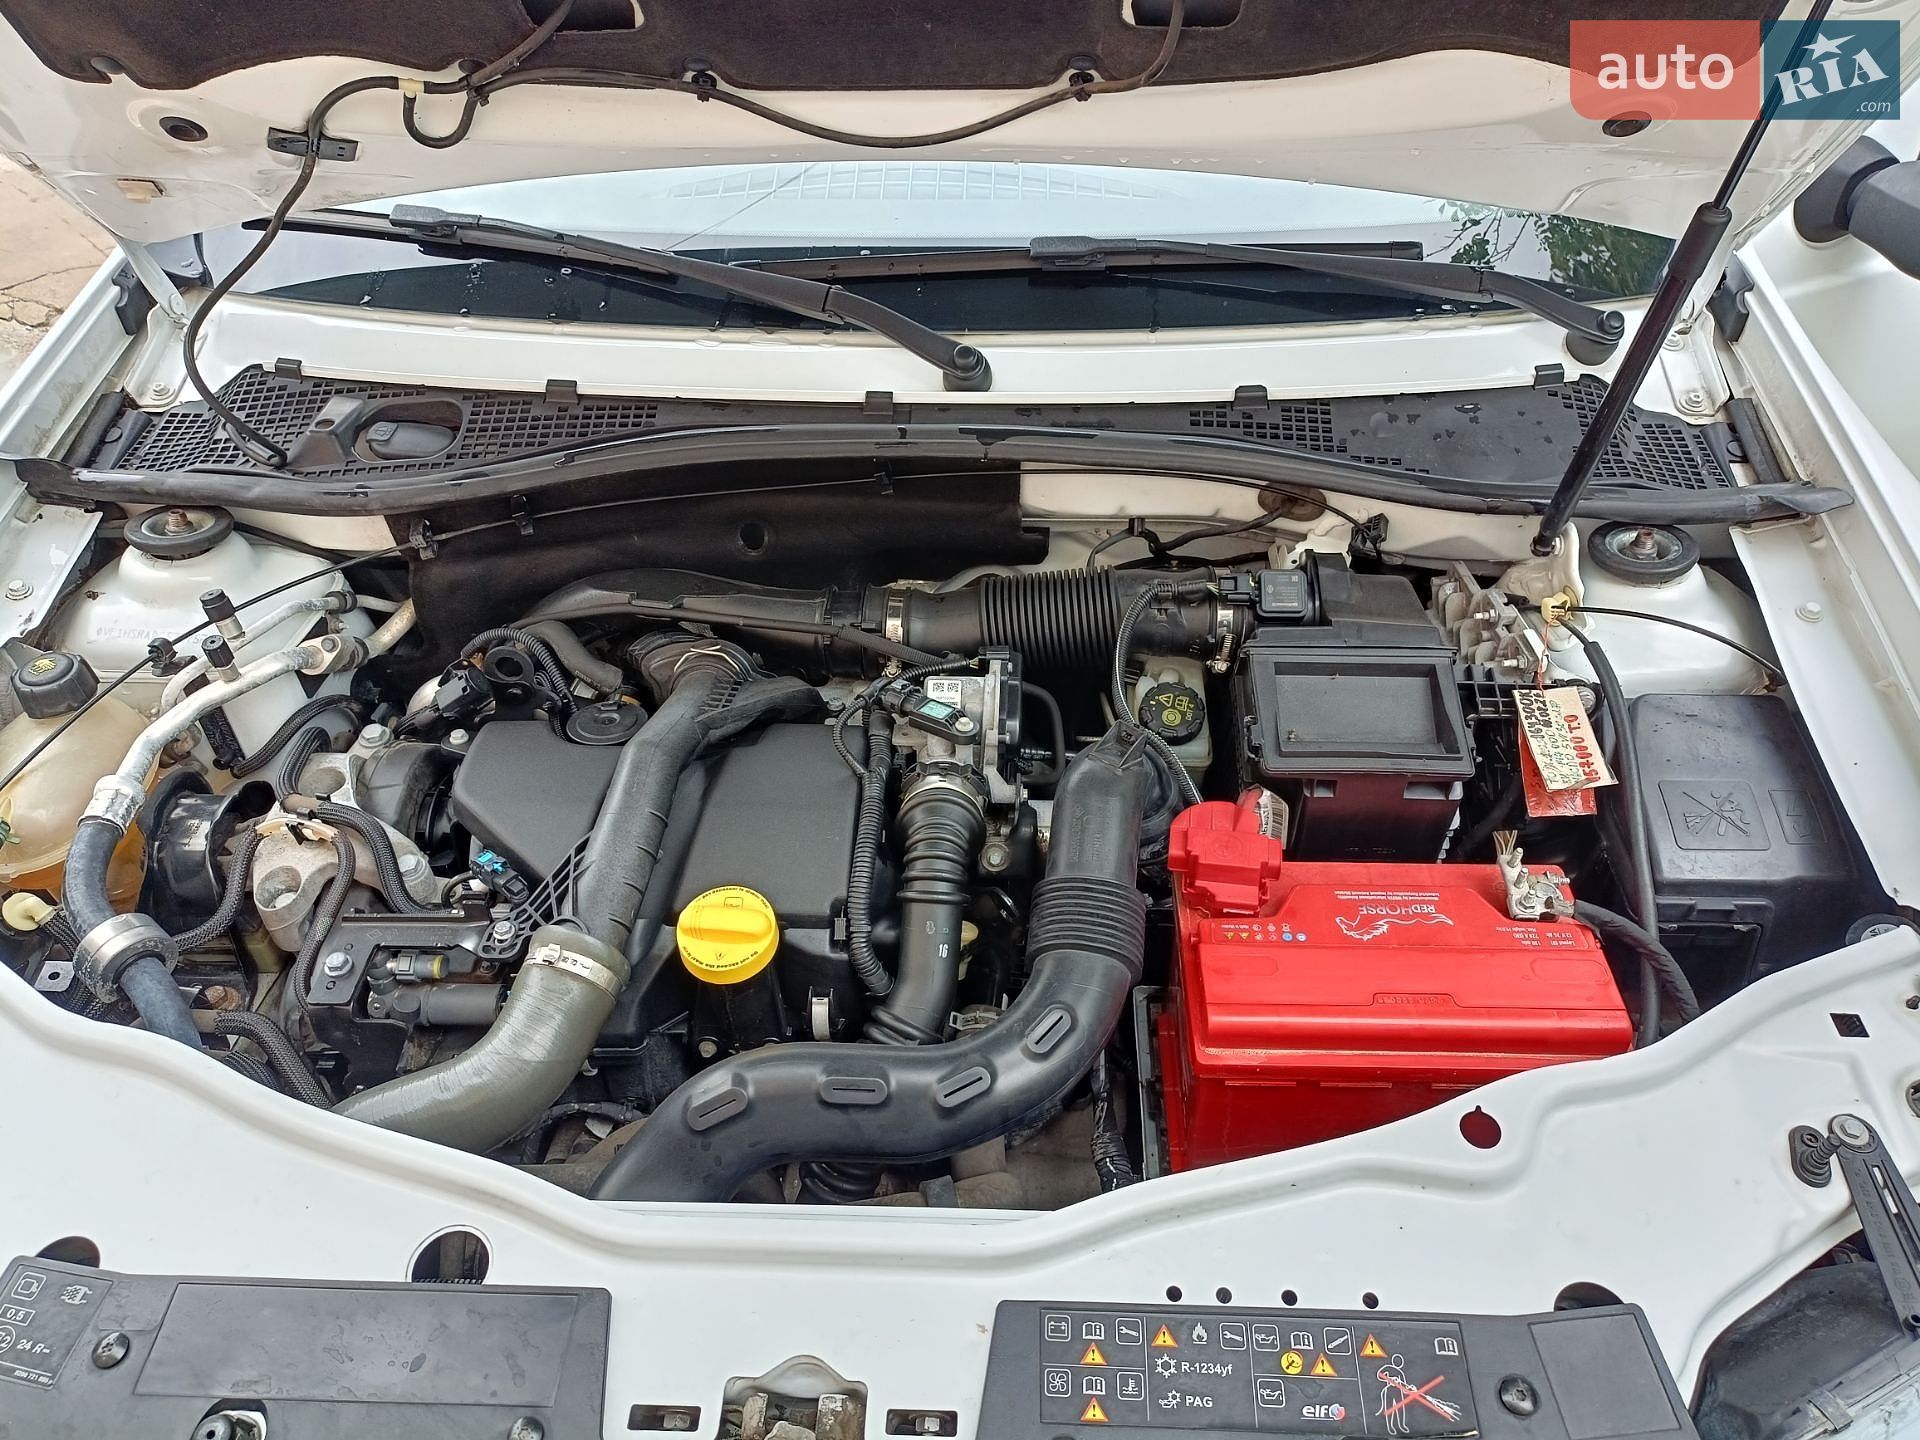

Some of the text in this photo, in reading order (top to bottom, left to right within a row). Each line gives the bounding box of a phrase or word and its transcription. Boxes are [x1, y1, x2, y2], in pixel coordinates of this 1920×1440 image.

[6, 1308, 25, 1321] 0,5
[16, 1338, 32, 1350] 24
[1180, 1361, 1232, 1376] R-1234yf
[1185, 1395, 1213, 1408] PAG
[1302, 1403, 1330, 1417] elf
